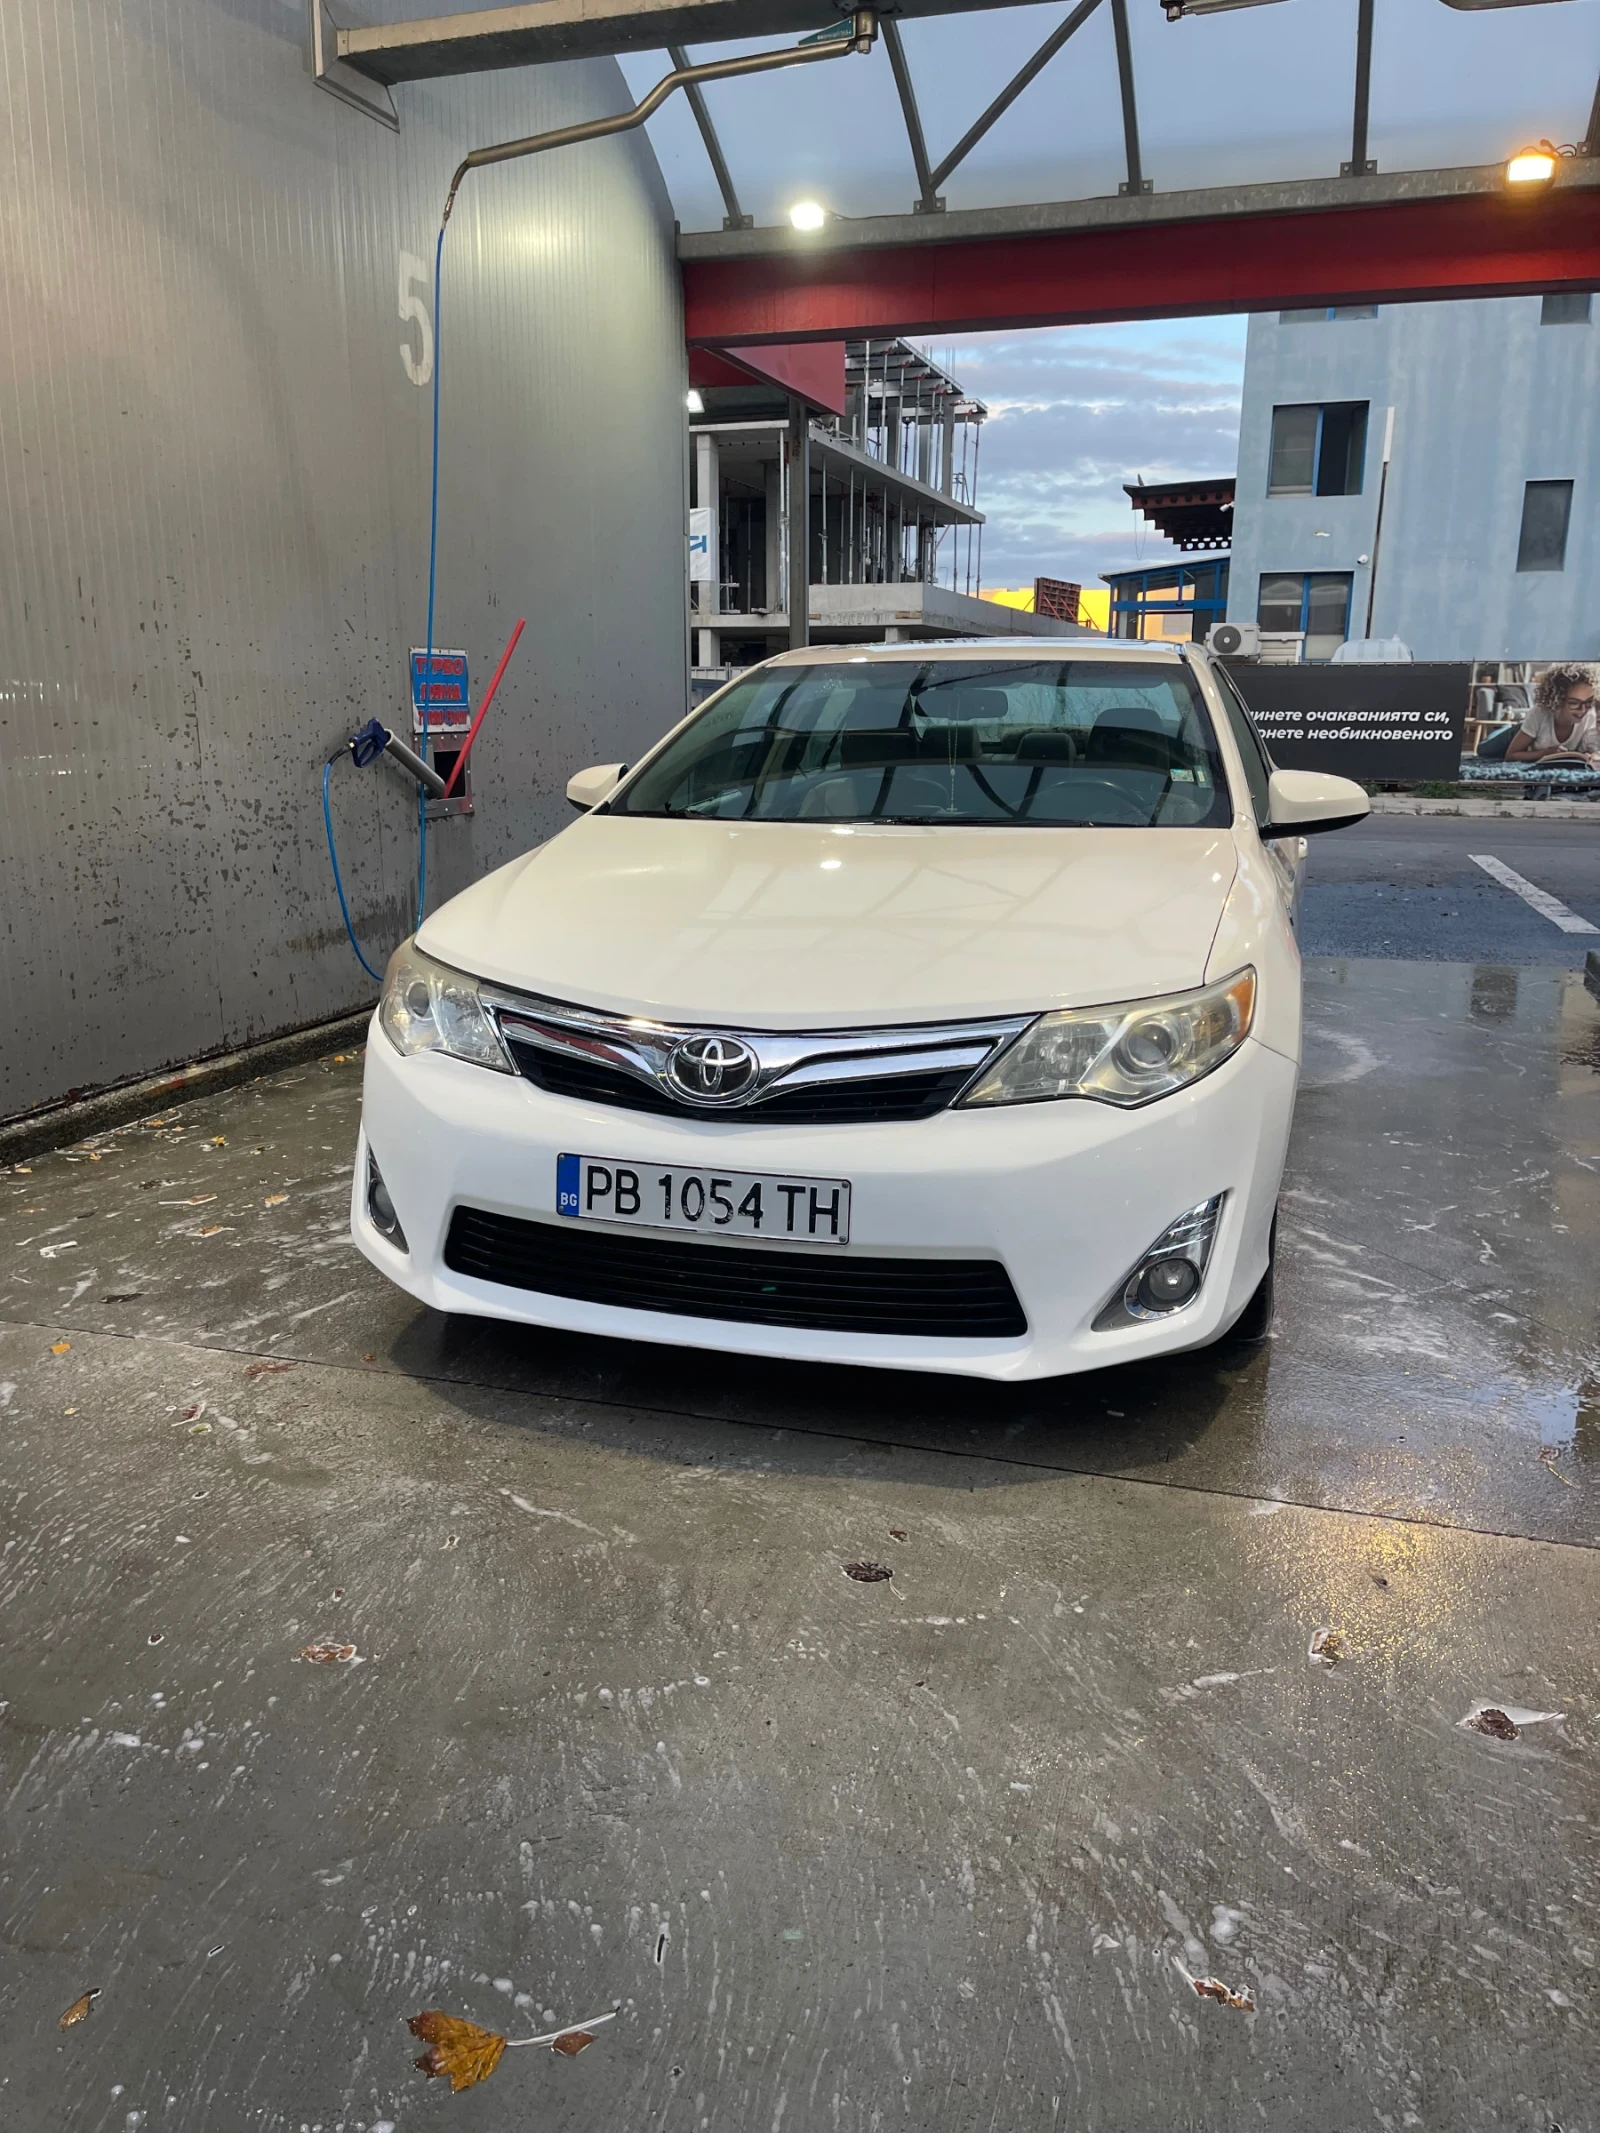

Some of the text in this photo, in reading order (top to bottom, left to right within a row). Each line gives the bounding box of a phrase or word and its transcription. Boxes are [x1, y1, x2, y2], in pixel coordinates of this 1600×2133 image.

[398, 249, 434, 386] 5
[1306, 711, 1421, 722] очакванията
[1424, 711, 1450, 724] си,
[1307, 726, 1454, 740] необикновеното
[560, 1192, 578, 1207] BG
[658, 1173, 764, 1229] 1054
